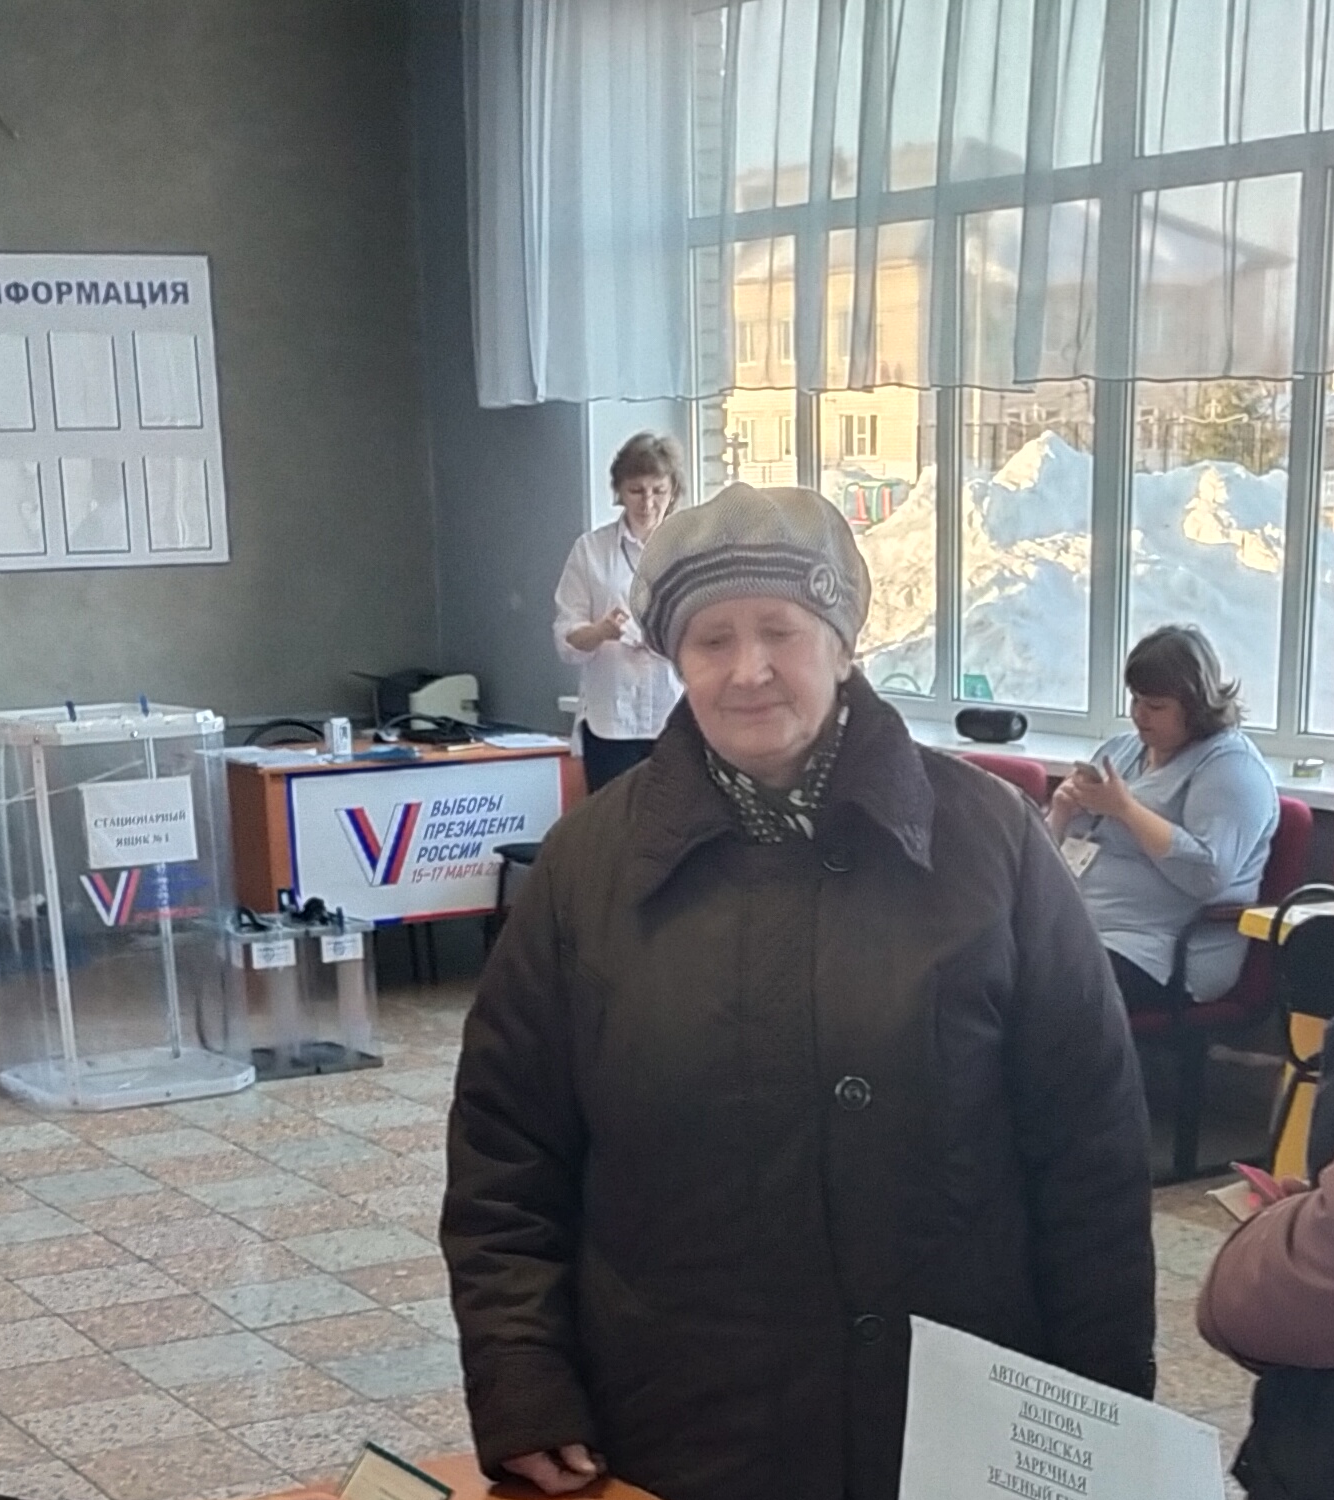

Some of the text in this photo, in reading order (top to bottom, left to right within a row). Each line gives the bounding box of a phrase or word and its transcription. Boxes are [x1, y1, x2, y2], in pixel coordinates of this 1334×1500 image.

[94, 810, 186, 829] СТАЦИОНАРНЫЙ
[430, 794, 504, 818] ВЫБОРЫ
[423, 814, 525, 841] ПРЕЗИДЕНТА
[416, 841, 482, 864] РОССИИ
[444, 862, 484, 880] МАРТА
[989, 1363, 1119, 1424] АВТОСТРОИТЕЛЕЙ
[1019, 1401, 1083, 1439] ДОЛГОВА
[1010, 1423, 1093, 1469] ЗАВОДСКАЯ
[1015, 1451, 1087, 1494] ЗАРЕЧНАЯ
